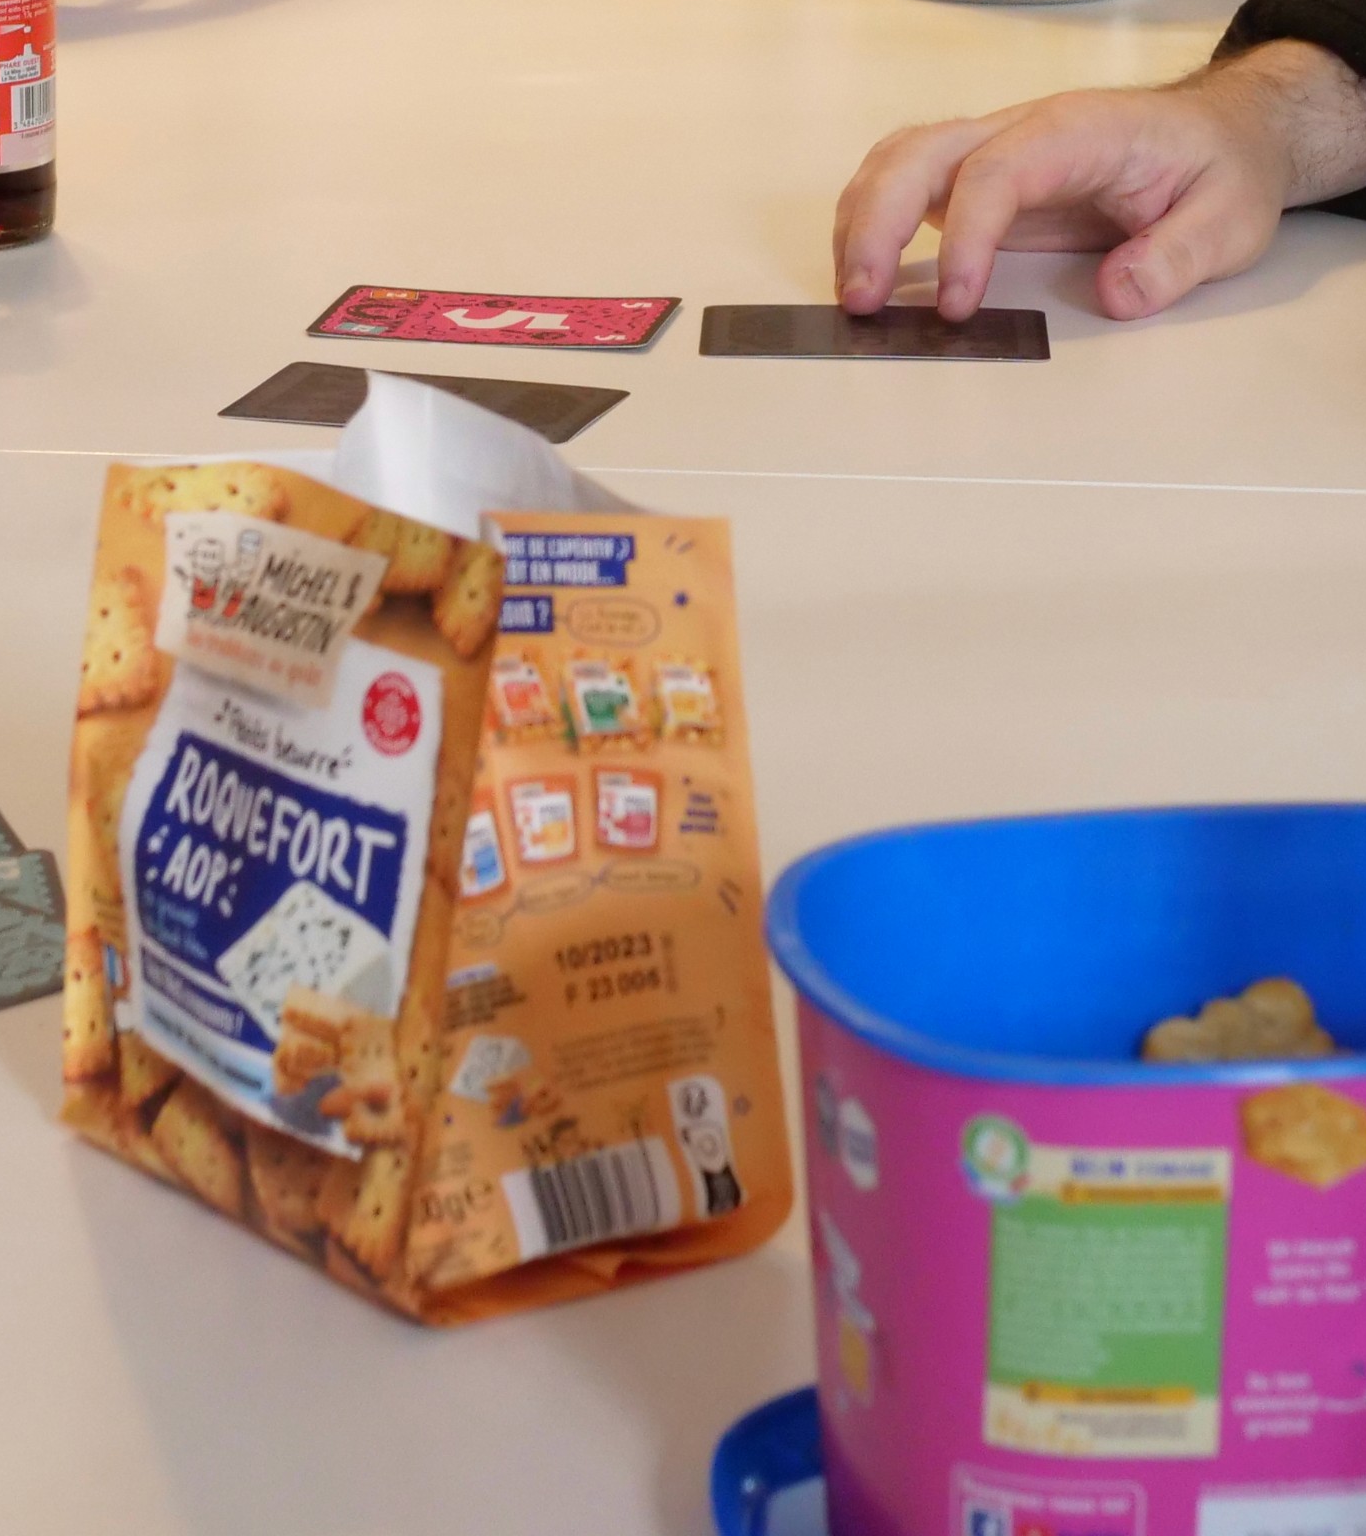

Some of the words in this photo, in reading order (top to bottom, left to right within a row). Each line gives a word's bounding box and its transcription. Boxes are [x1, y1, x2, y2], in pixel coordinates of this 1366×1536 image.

[0, 61, 21, 69] PHARE
[164, 743, 398, 906] ROQUEFORT
[161, 833, 229, 908] AOP
